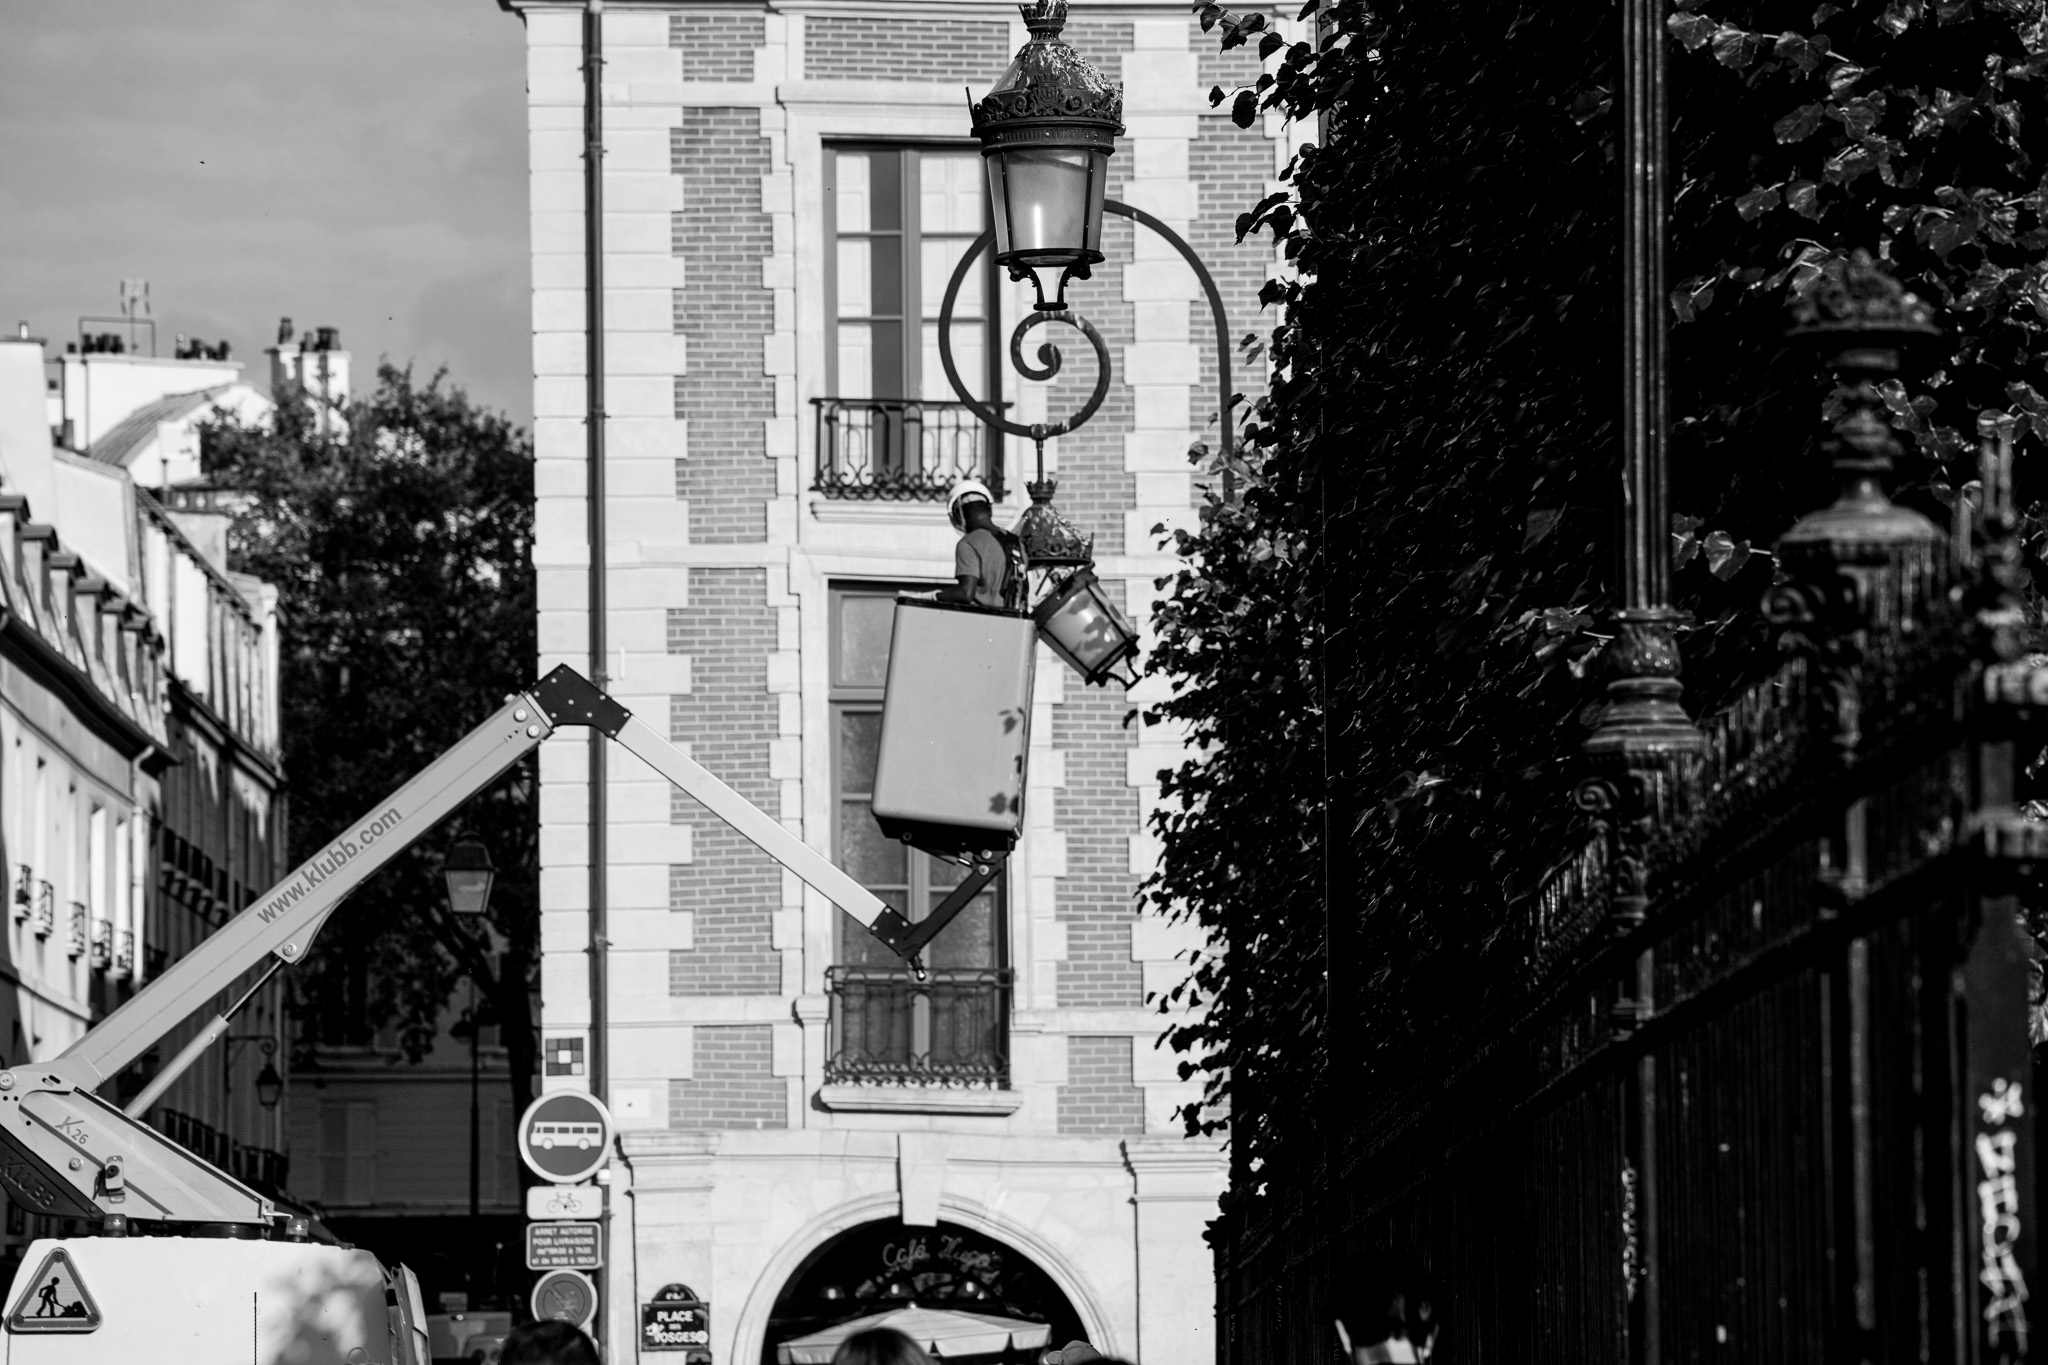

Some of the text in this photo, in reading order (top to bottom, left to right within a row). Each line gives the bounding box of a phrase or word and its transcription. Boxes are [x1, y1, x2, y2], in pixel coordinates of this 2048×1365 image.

[257, 808, 402, 924] www.klubb.com
[882, 1238, 931, 1271] Café
[657, 1310, 694, 1322] PLACE
